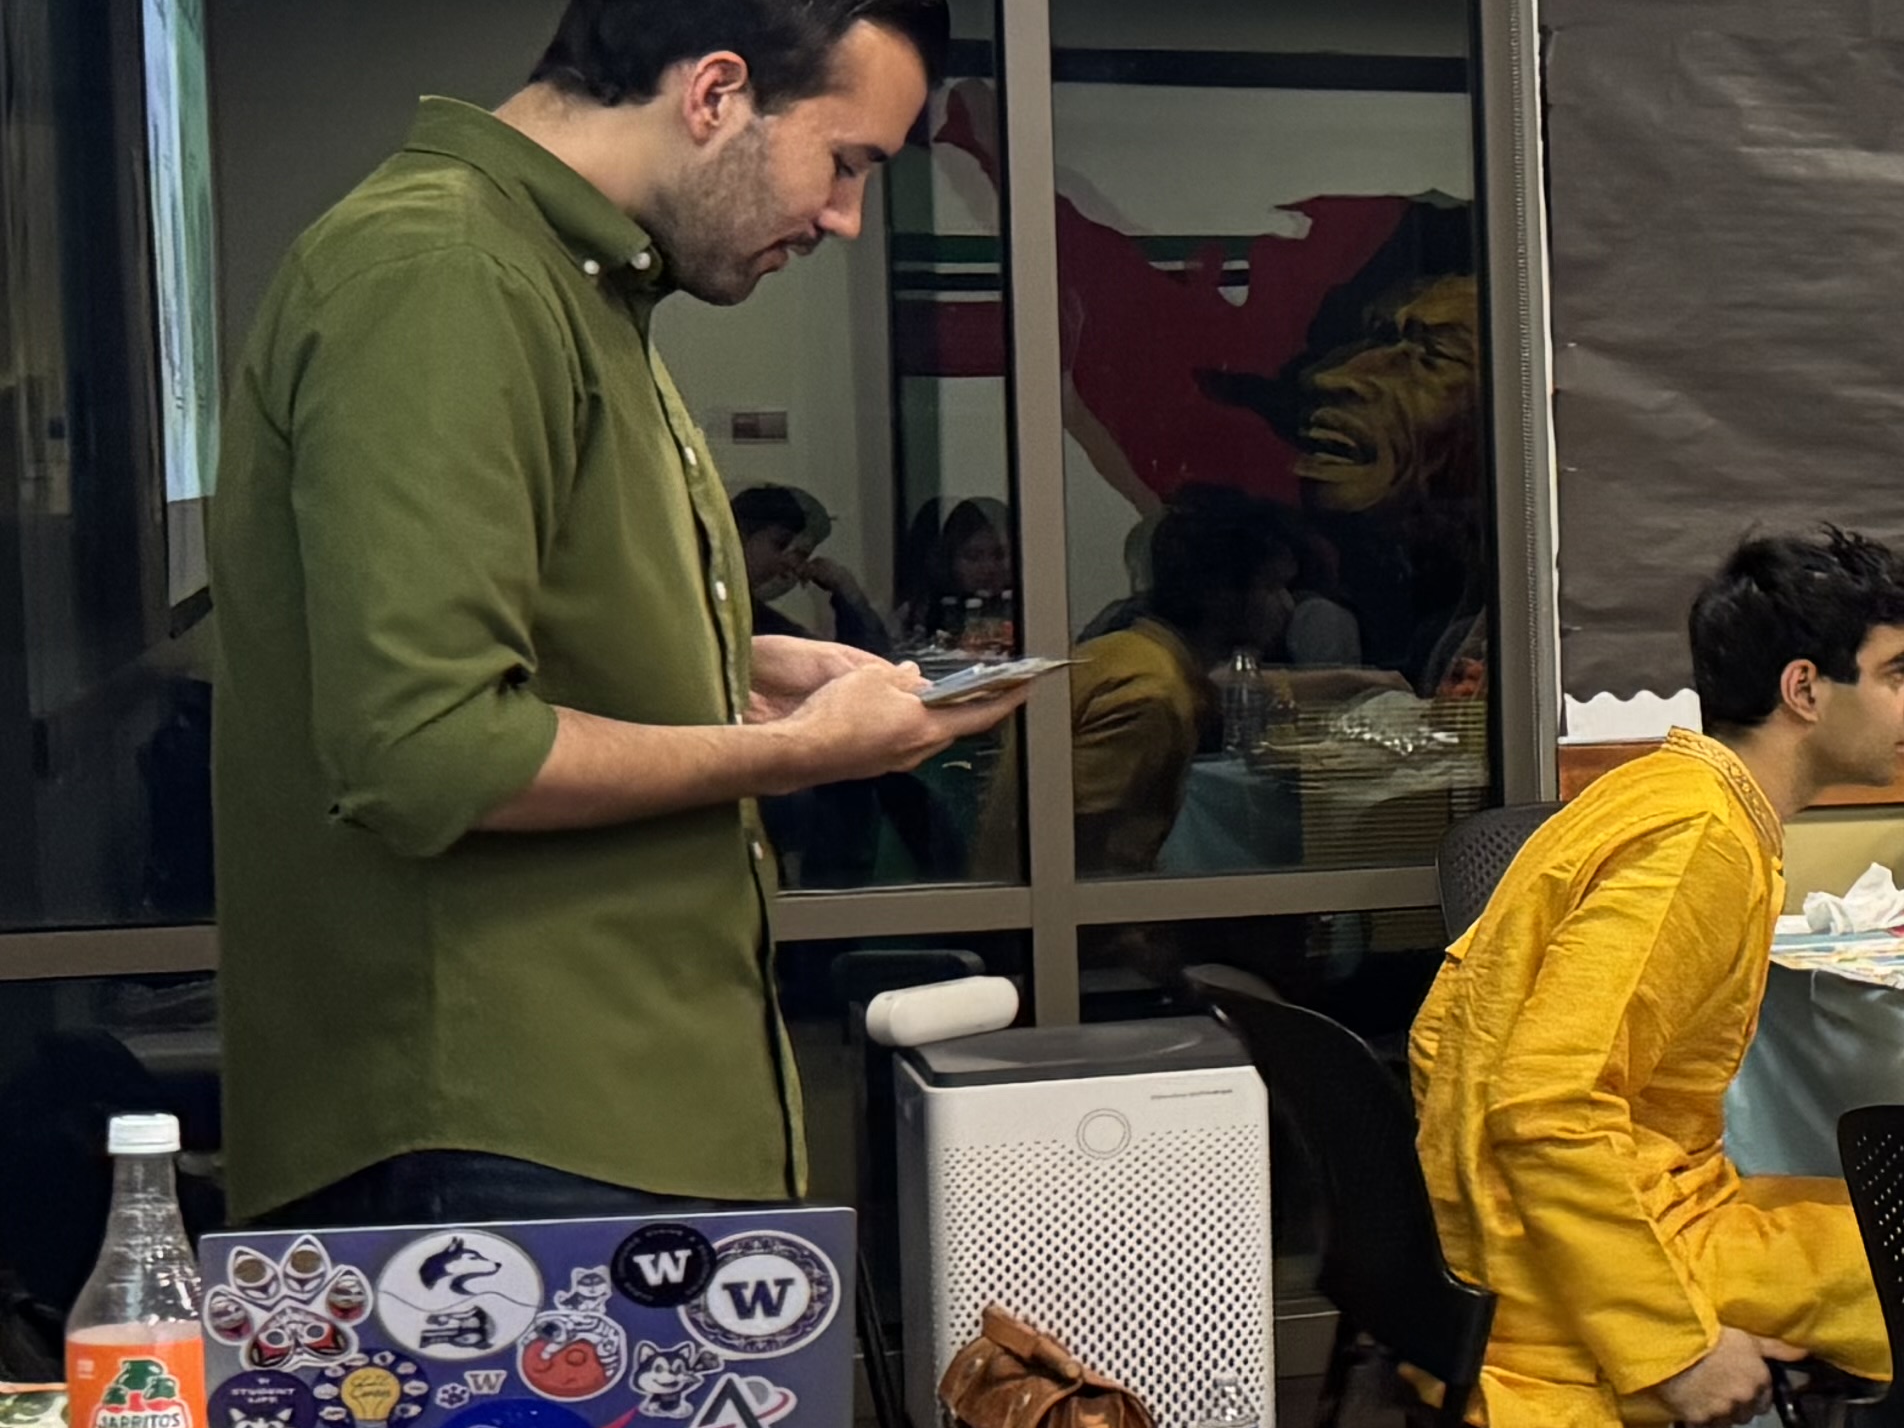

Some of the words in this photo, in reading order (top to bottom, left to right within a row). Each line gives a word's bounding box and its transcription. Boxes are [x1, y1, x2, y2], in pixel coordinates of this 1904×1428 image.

[633, 1248, 693, 1286] W
[721, 1277, 796, 1320] W
[230, 1387, 296, 1396] STUDENT
